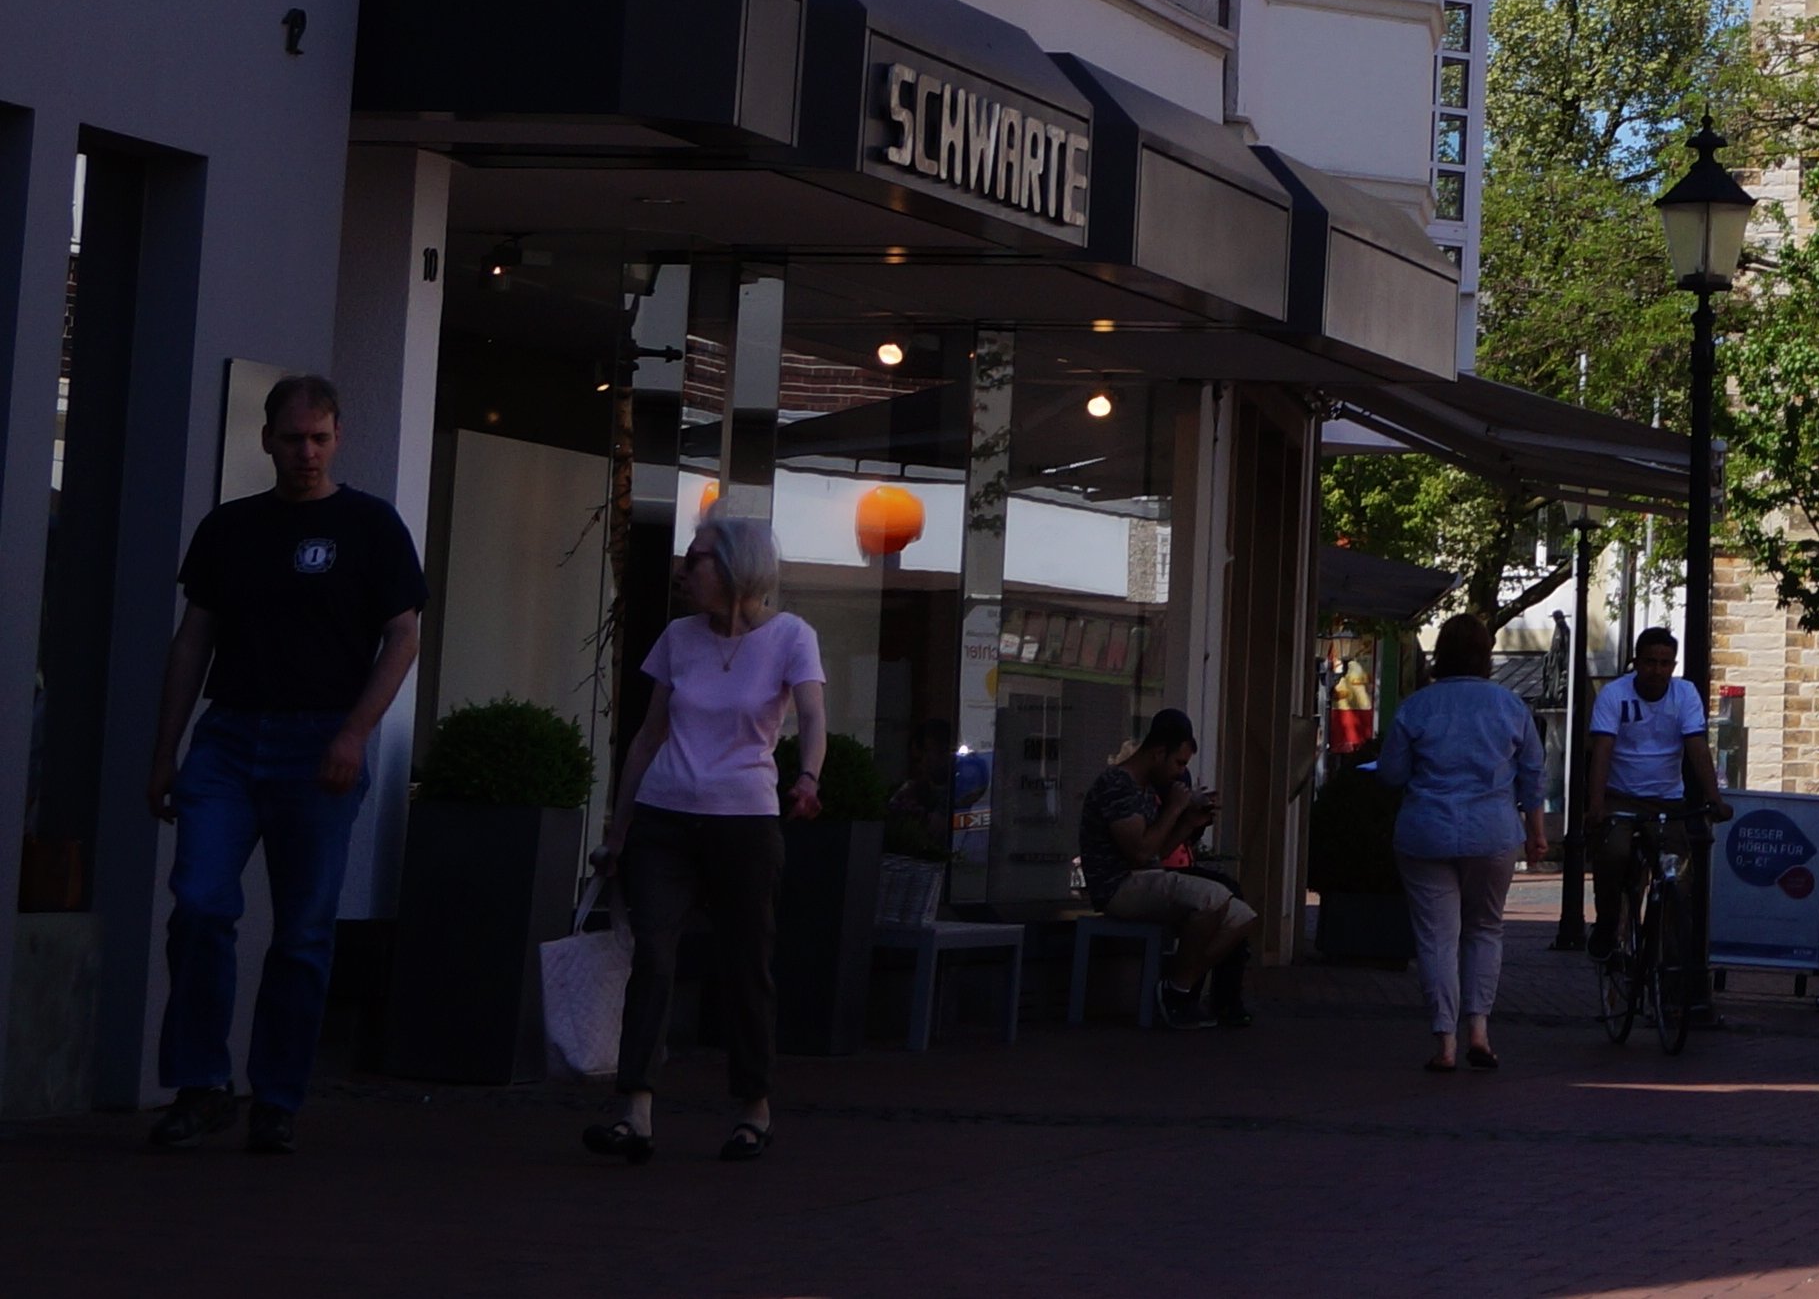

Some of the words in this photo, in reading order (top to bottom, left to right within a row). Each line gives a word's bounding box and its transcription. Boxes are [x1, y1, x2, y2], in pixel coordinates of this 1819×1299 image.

[888, 63, 1089, 227] SCHWARTE
[423, 247, 438, 282] 10
[1738, 827, 1784, 840] BESSER
[1737, 840, 1778, 854] HÖREN
